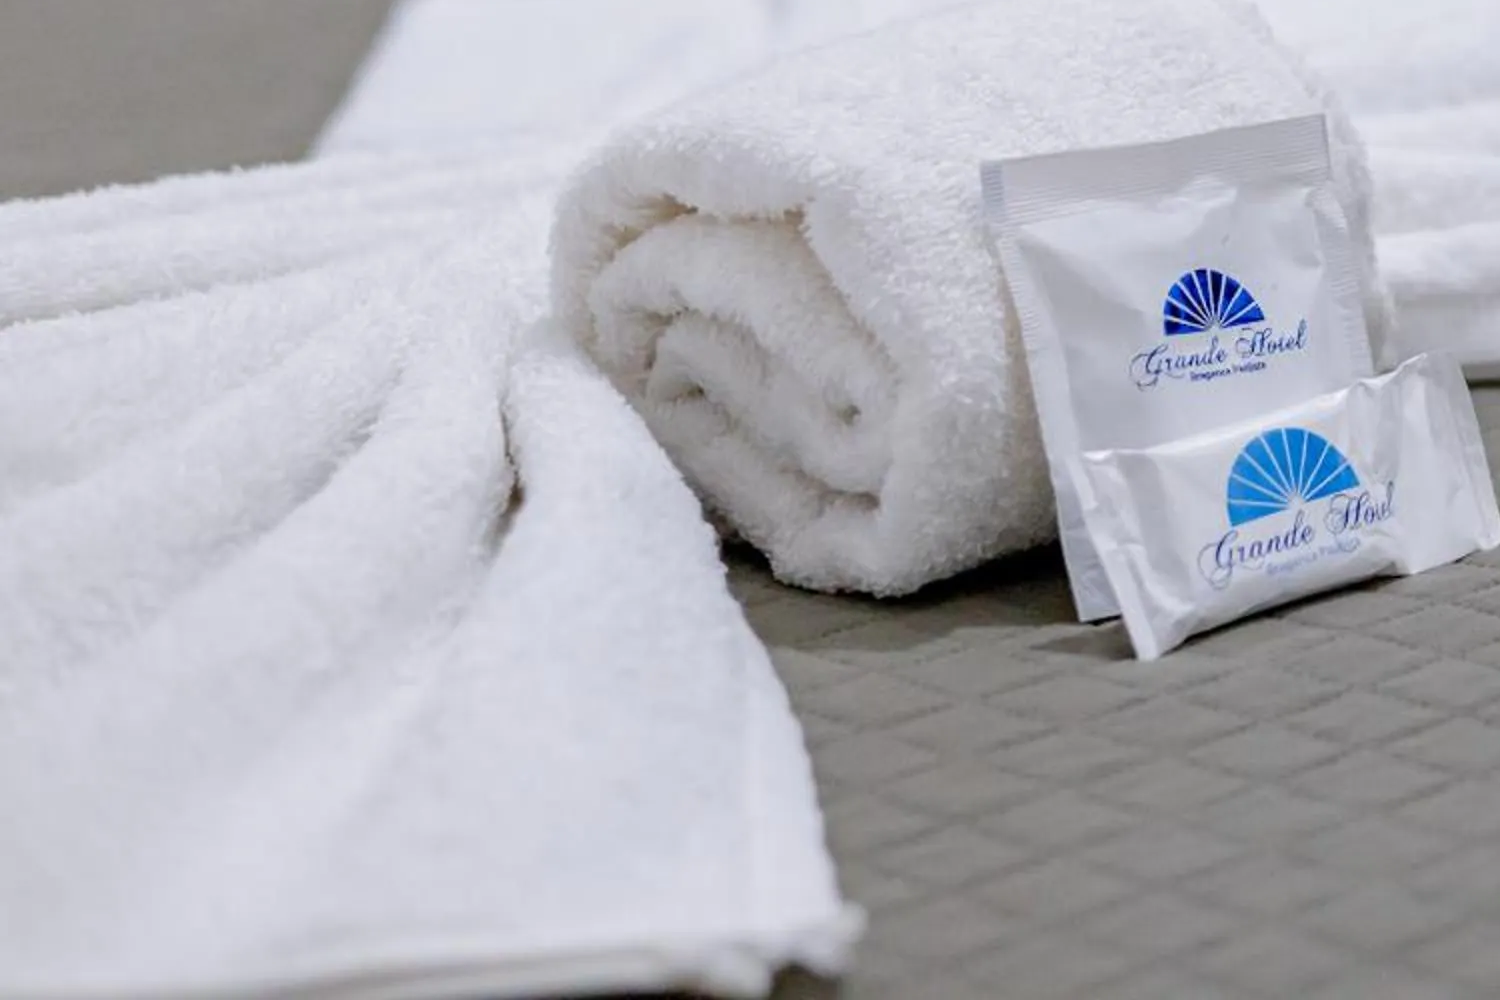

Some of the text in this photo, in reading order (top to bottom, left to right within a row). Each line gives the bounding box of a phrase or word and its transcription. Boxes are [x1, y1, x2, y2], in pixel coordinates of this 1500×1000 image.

[1130, 317, 1308, 391] Grande Hotel
[1198, 510, 1315, 590] Grande
